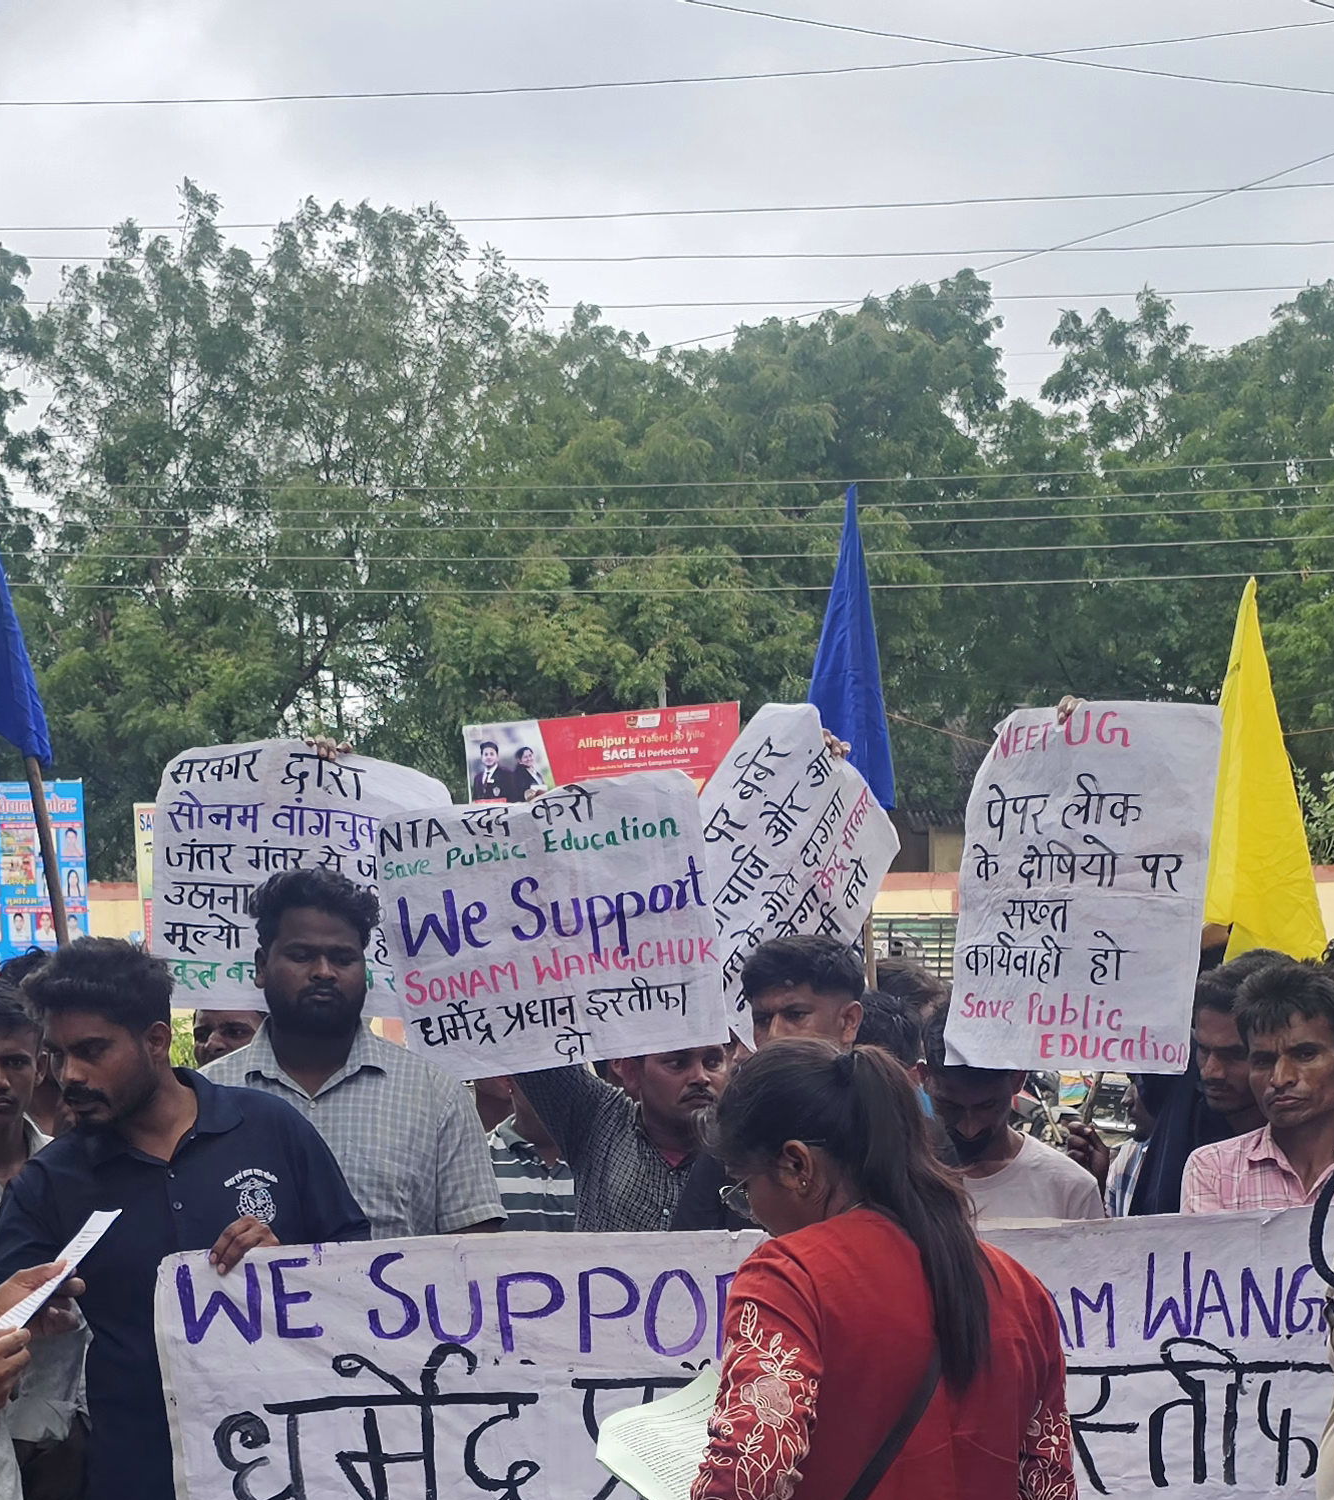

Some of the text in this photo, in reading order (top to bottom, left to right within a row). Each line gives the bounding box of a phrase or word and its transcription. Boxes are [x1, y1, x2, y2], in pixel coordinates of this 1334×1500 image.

[577, 735, 627, 750] Alirajpur
[602, 747, 637, 761] SAGE
[993, 710, 1131, 761] NEET UG
[169, 749, 366, 800] सरकार द्वारा
[167, 790, 265, 833] सोनम
[380, 818, 451, 857] NTA
[531, 784, 601, 826] करो
[986, 773, 1143, 841] पेपर लीक
[166, 839, 237, 874] जंतर
[446, 842, 527, 869] Public
[543, 816, 681, 853] Education
[973, 843, 999, 881] के
[1135, 853, 1185, 893] पर
[842, 855, 869, 909] करो
[397, 854, 707, 963] We Support
[1002, 898, 1074, 933] सख्त
[404, 961, 520, 1006] SONAM
[531, 935, 720, 985] WANGCHUK
[1087, 930, 1139, 985] हो
[496, 994, 577, 1038] प्रधान
[586, 976, 690, 1023] इस्तीफा
[960, 991, 1123, 1032] Save Public
[554, 1025, 592, 1063] दो
[175, 1255, 324, 1346] WE
[366, 1250, 732, 1358] SUPPO
[1143, 1251, 1327, 1342] WANG
